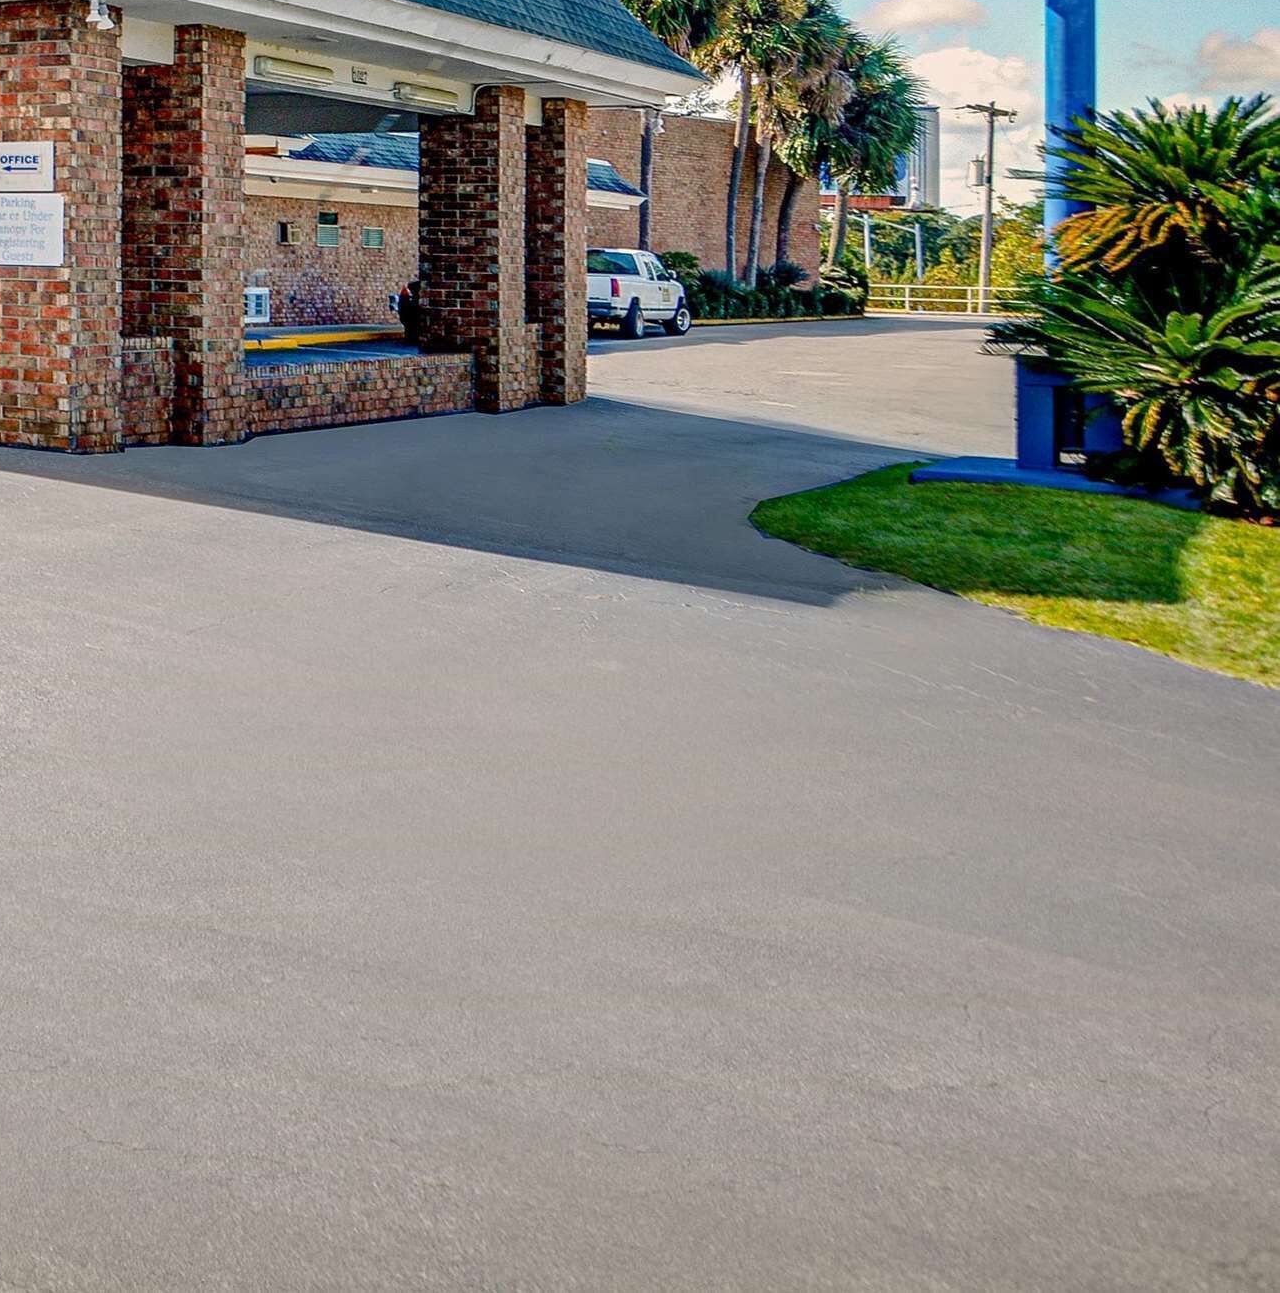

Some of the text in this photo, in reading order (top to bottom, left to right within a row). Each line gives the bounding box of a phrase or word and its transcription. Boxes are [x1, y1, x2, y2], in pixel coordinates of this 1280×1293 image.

[0, 155, 39, 164] OFFICE
[0, 197, 36, 209] Parking
[23, 210, 54, 221] Under
[30, 224, 45, 234] For
[2, 251, 34, 261] Guests
